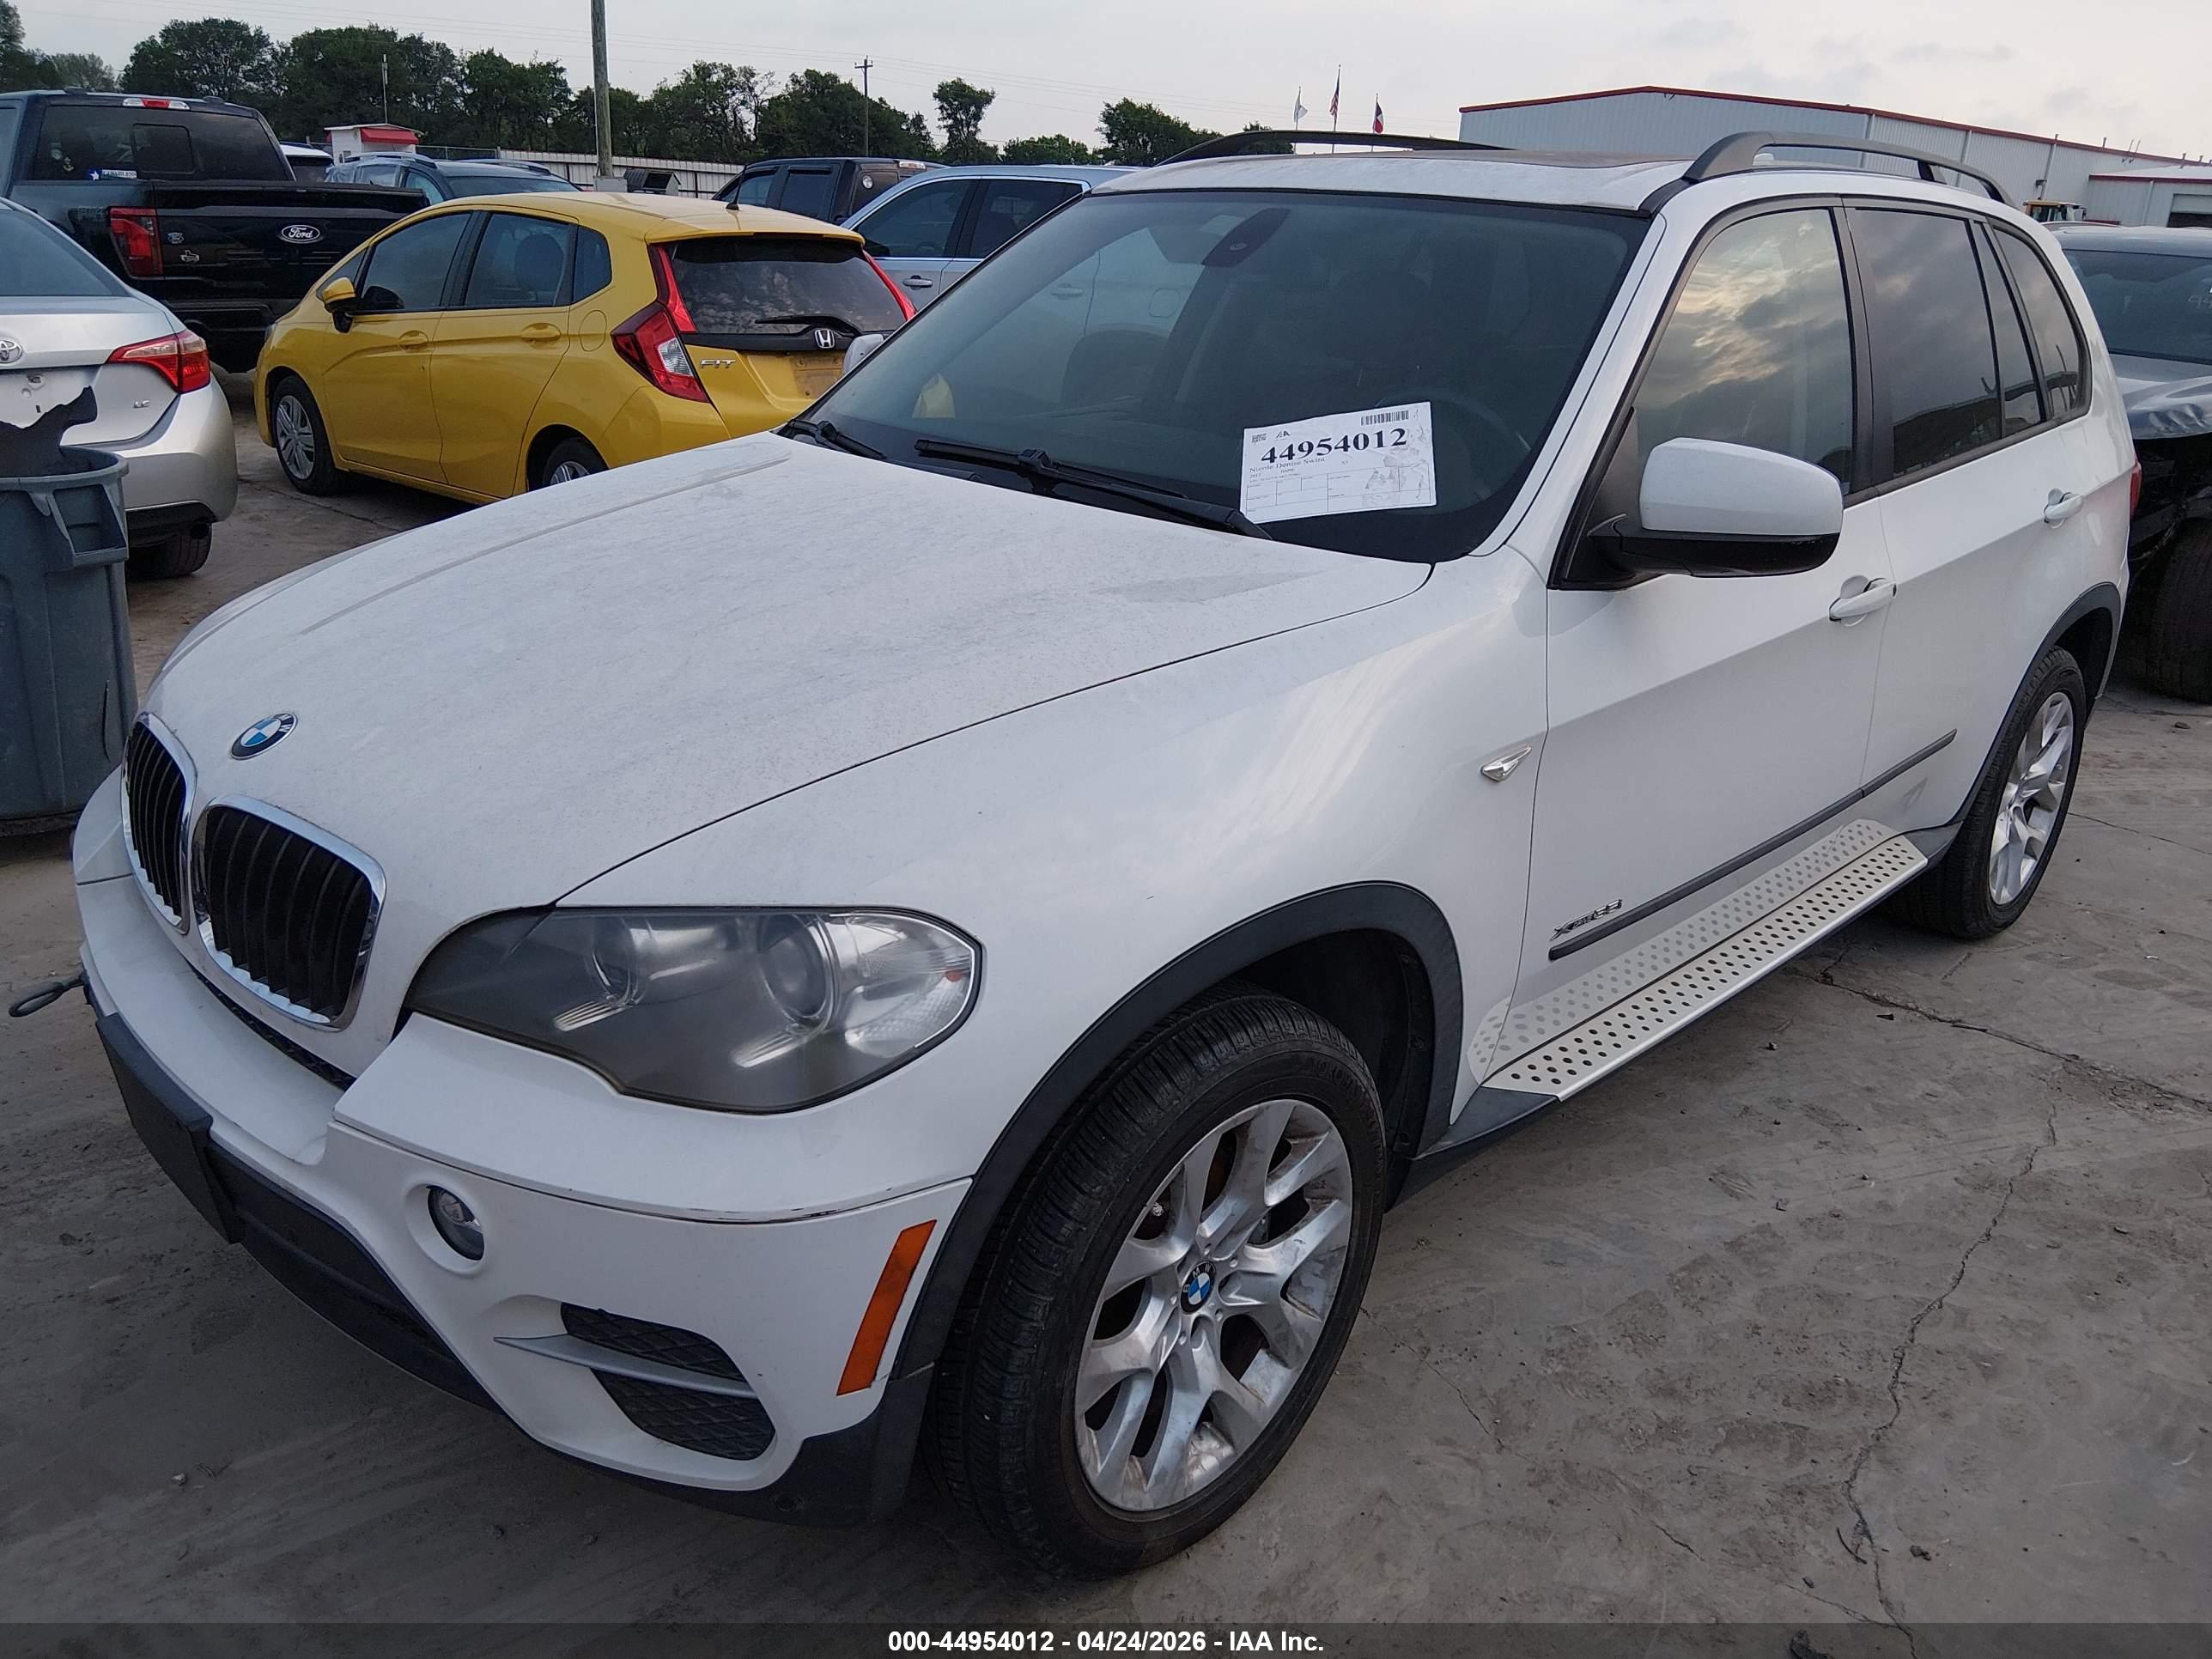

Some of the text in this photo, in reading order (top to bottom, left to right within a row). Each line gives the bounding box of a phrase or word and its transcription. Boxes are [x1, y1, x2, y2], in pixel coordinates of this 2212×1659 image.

[289, 227, 313, 239] Ford
[701, 359, 736, 368] FIT
[1261, 428, 1407, 464] 44954012
